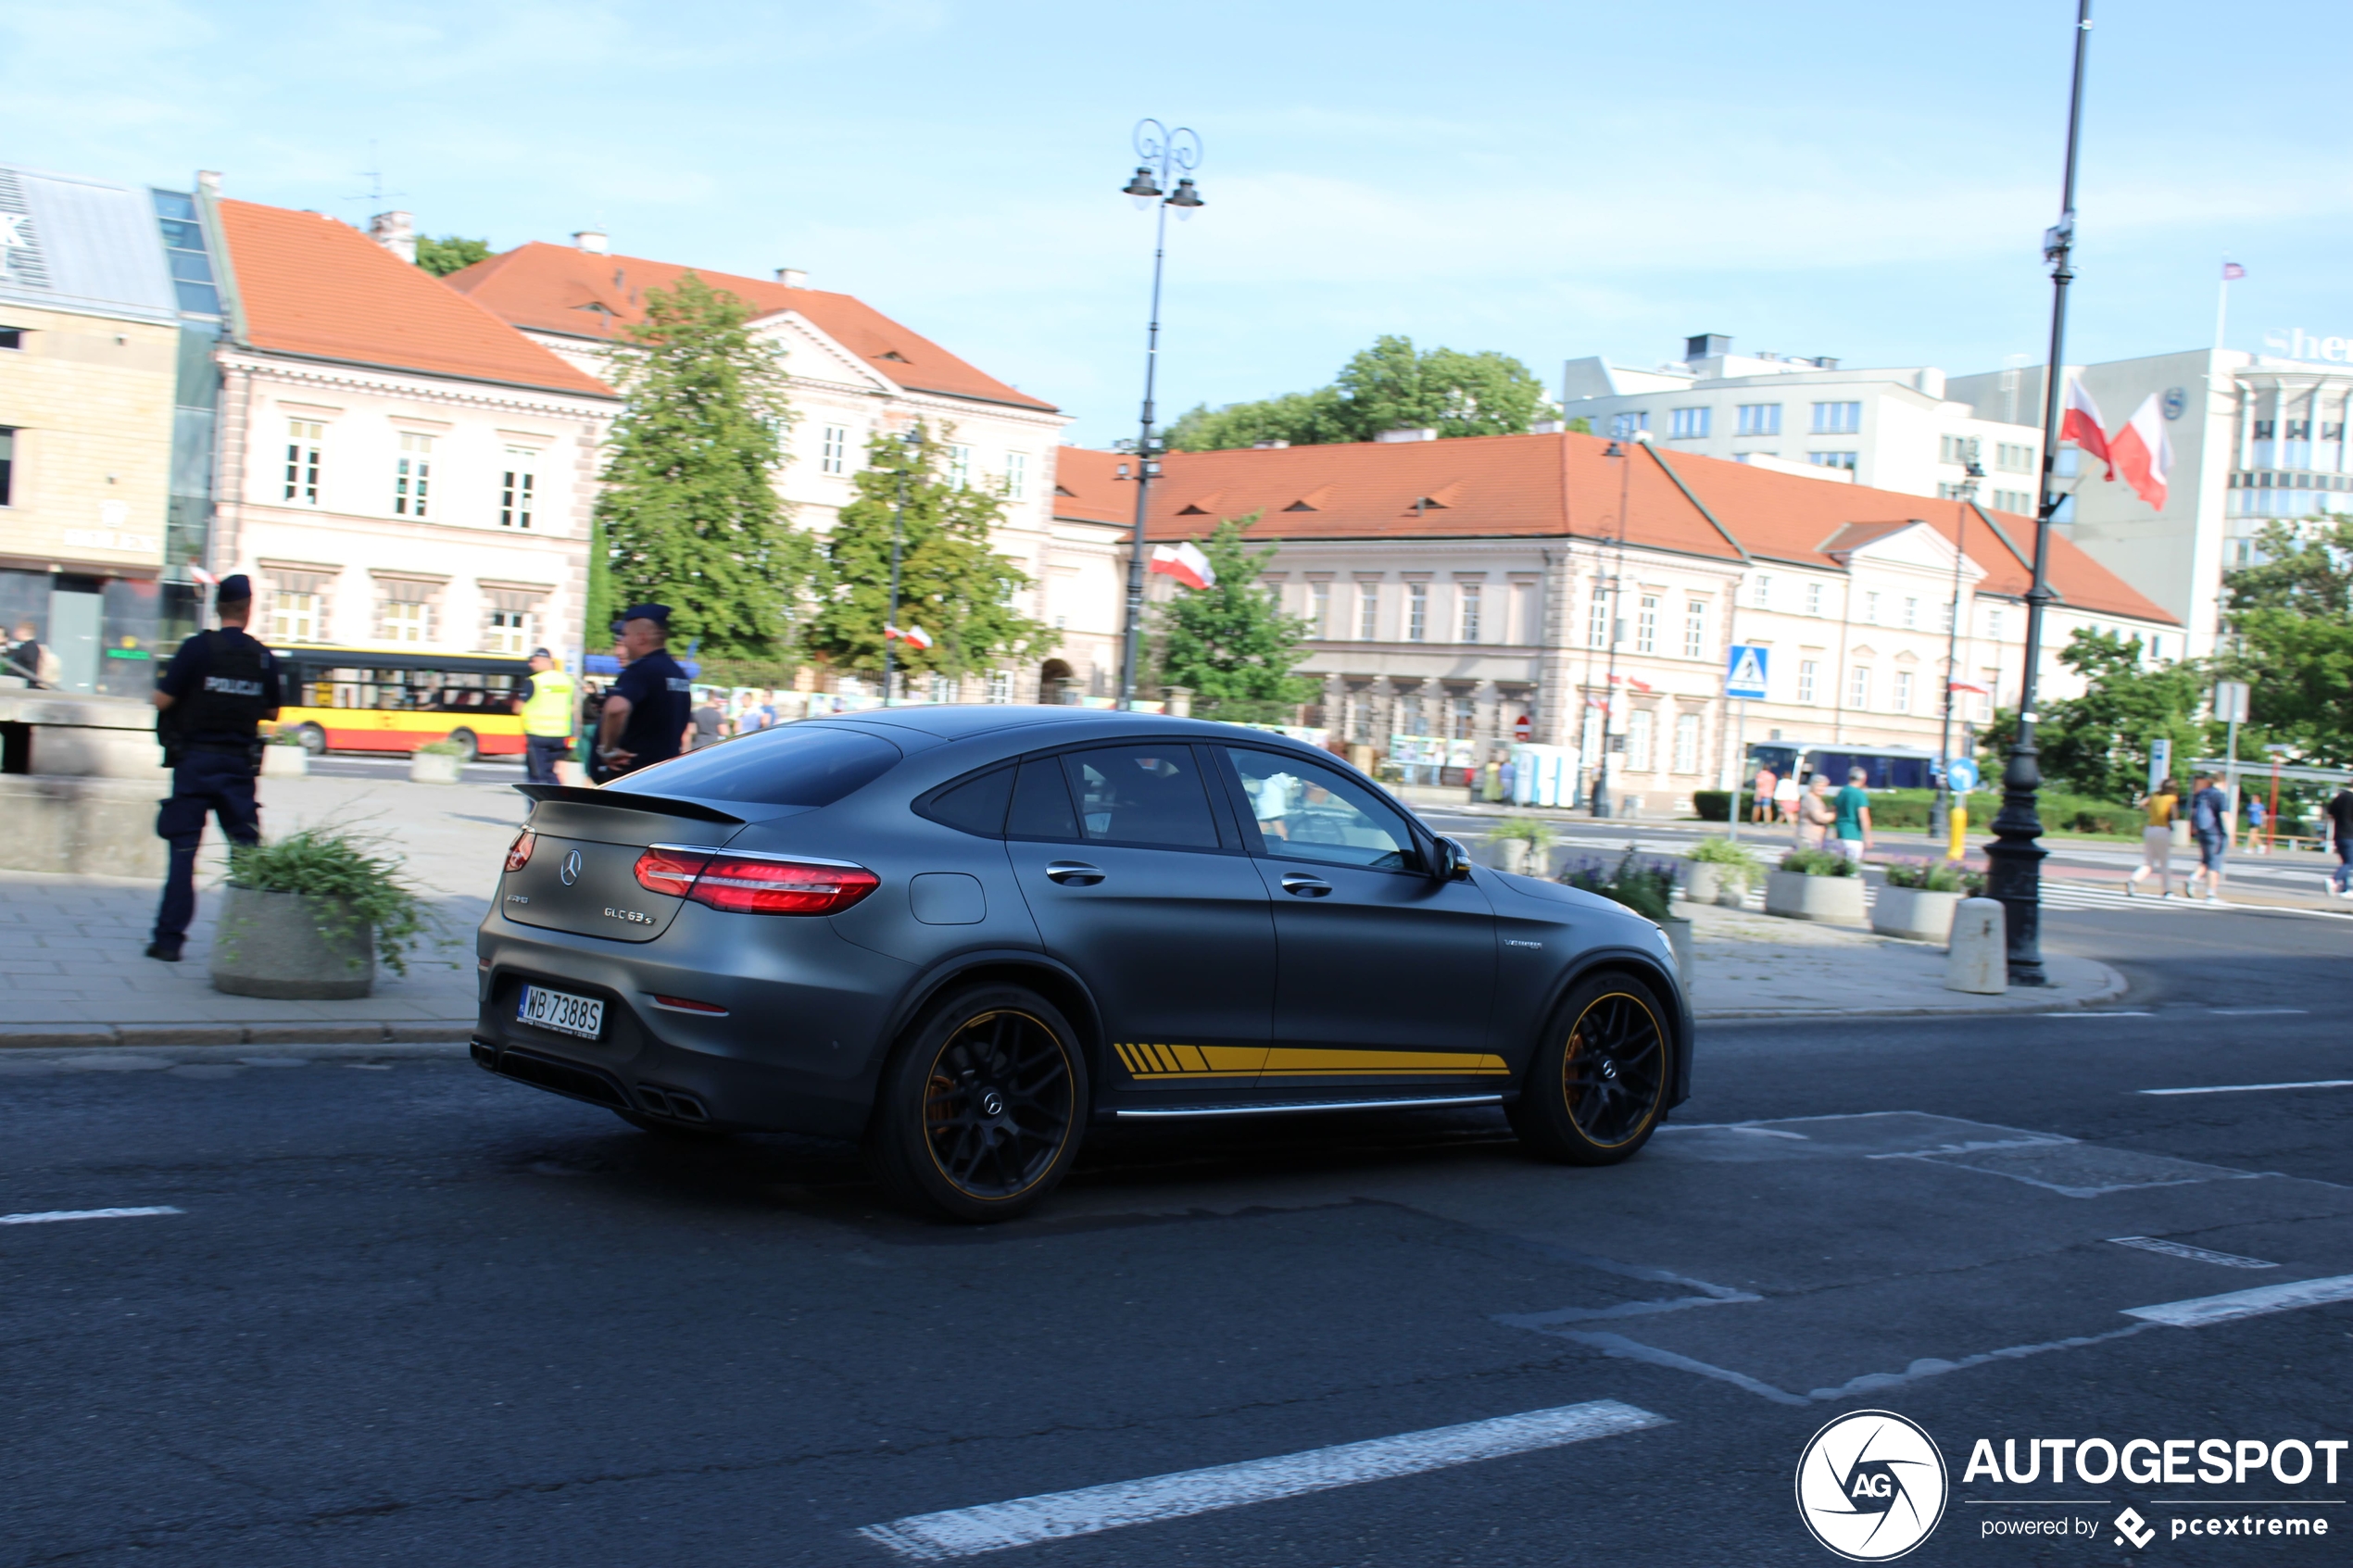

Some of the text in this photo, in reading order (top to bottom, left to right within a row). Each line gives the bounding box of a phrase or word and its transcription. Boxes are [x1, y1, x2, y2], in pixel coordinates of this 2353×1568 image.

[604, 907, 626, 920] GLC
[627, 910, 644, 922] 63
[527, 988, 547, 1019] WB
[549, 994, 599, 1031] 7388S
